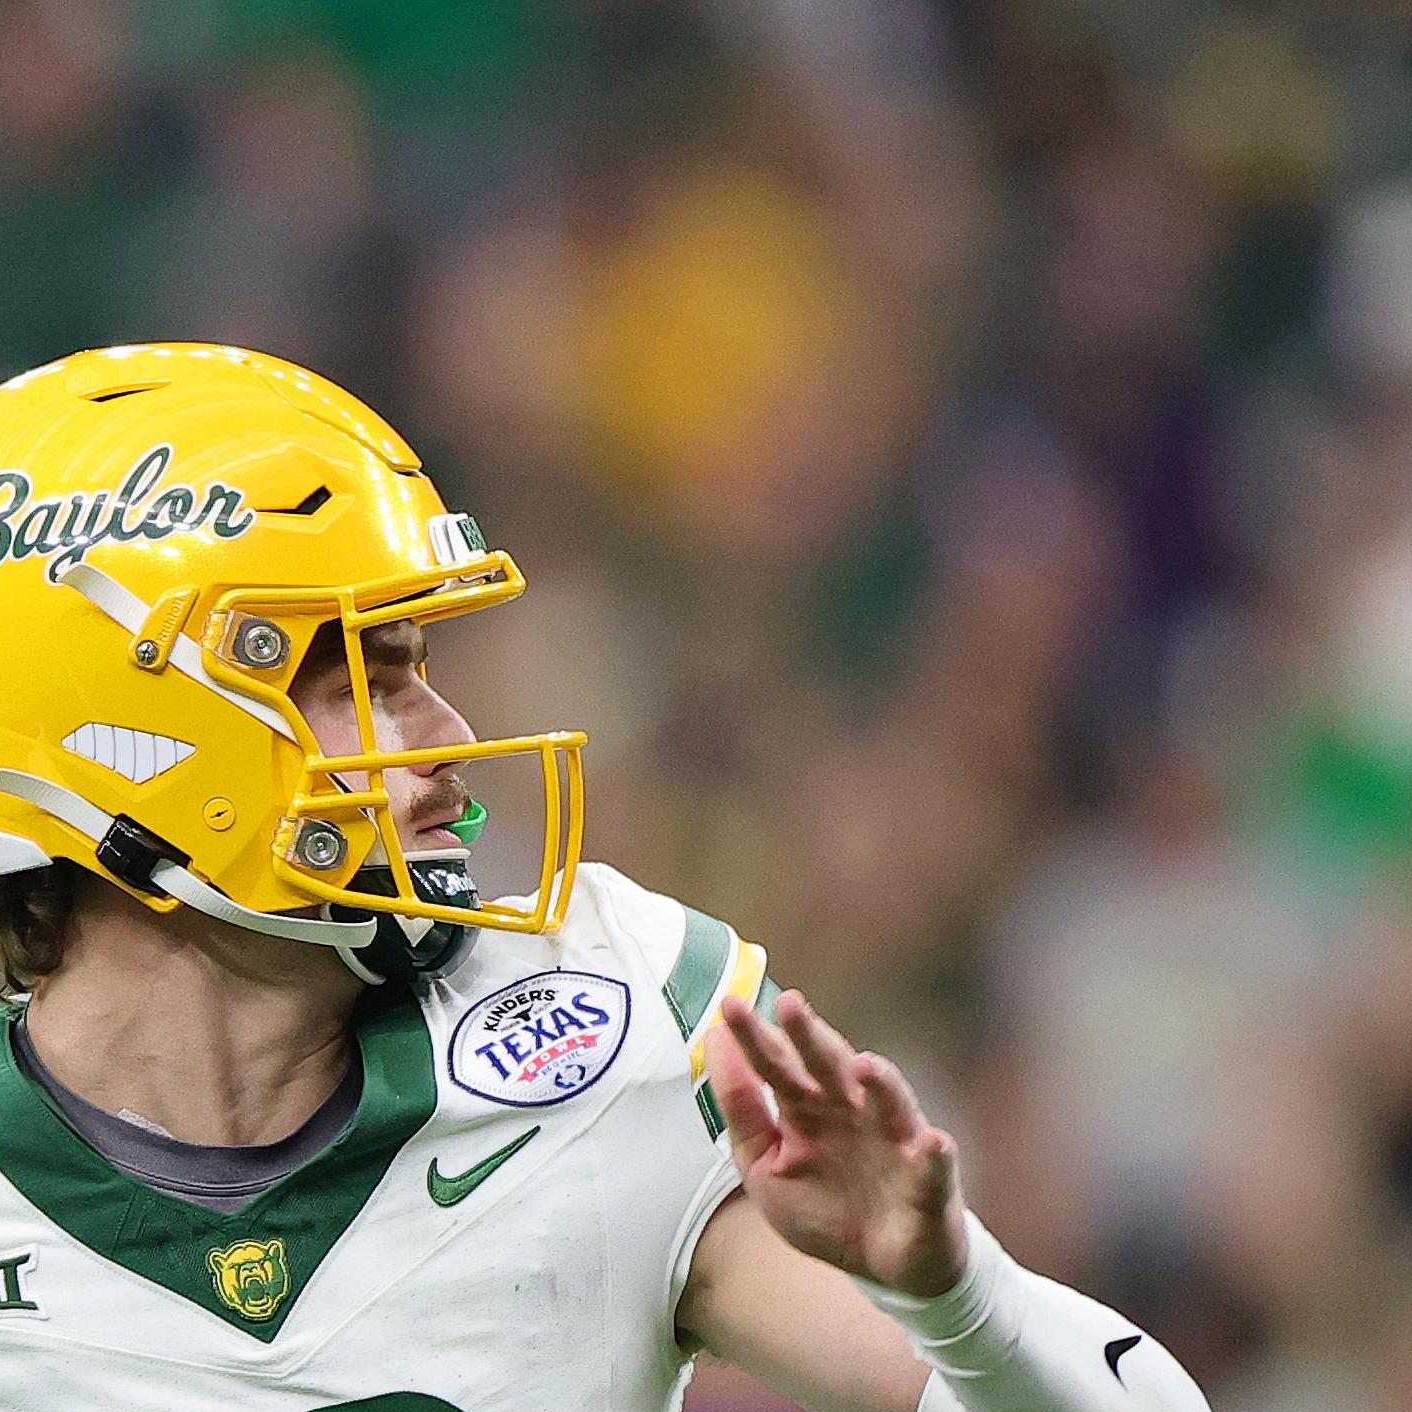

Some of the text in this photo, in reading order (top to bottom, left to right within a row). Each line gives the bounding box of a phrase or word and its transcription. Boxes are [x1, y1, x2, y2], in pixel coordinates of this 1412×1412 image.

[483, 989, 556, 1032] KINDER'S
[475, 992, 609, 1080] TEXAS
[528, 1036, 587, 1073] BOWL
